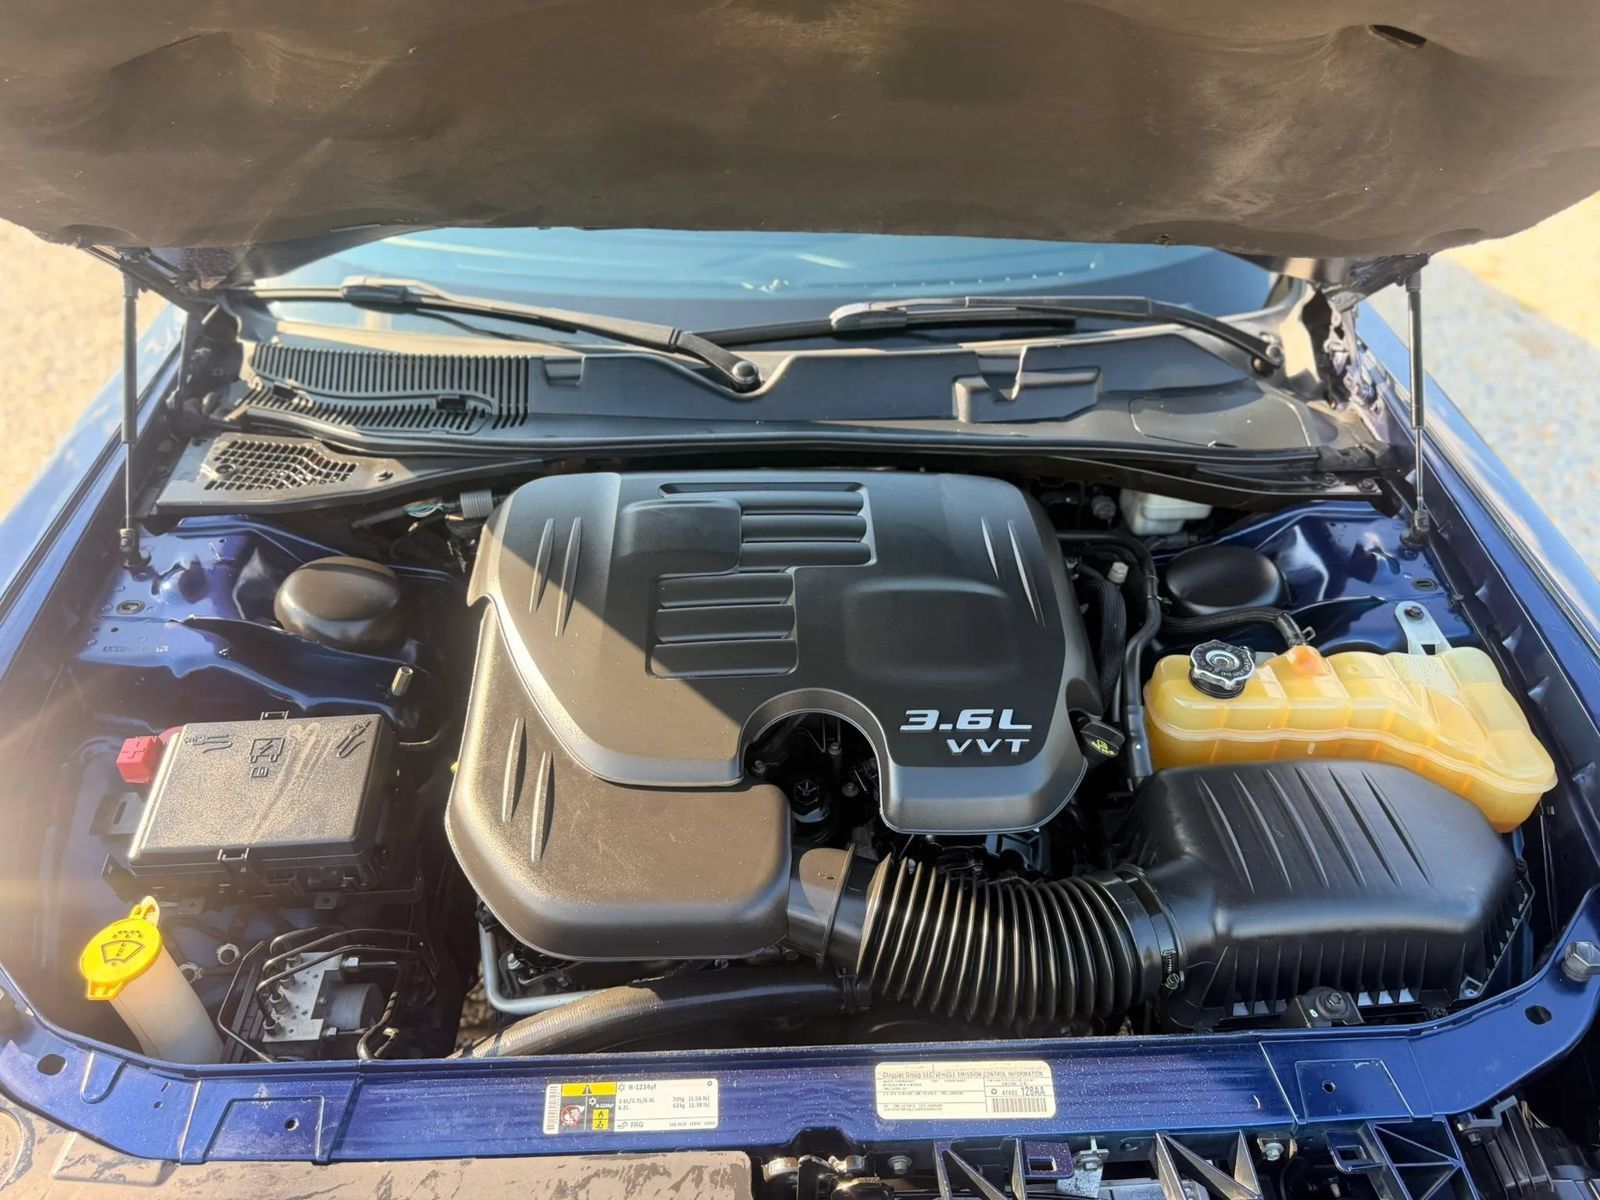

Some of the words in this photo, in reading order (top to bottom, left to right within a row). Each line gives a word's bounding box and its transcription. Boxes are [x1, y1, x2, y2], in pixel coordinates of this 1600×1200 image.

[899, 708, 1033, 732] 3.6L
[946, 738, 1030, 756] VVT
[905, 1071, 922, 1079] Group
[628, 1083, 657, 1091] R-1234yf
[1021, 1086, 1047, 1096] 128AA
